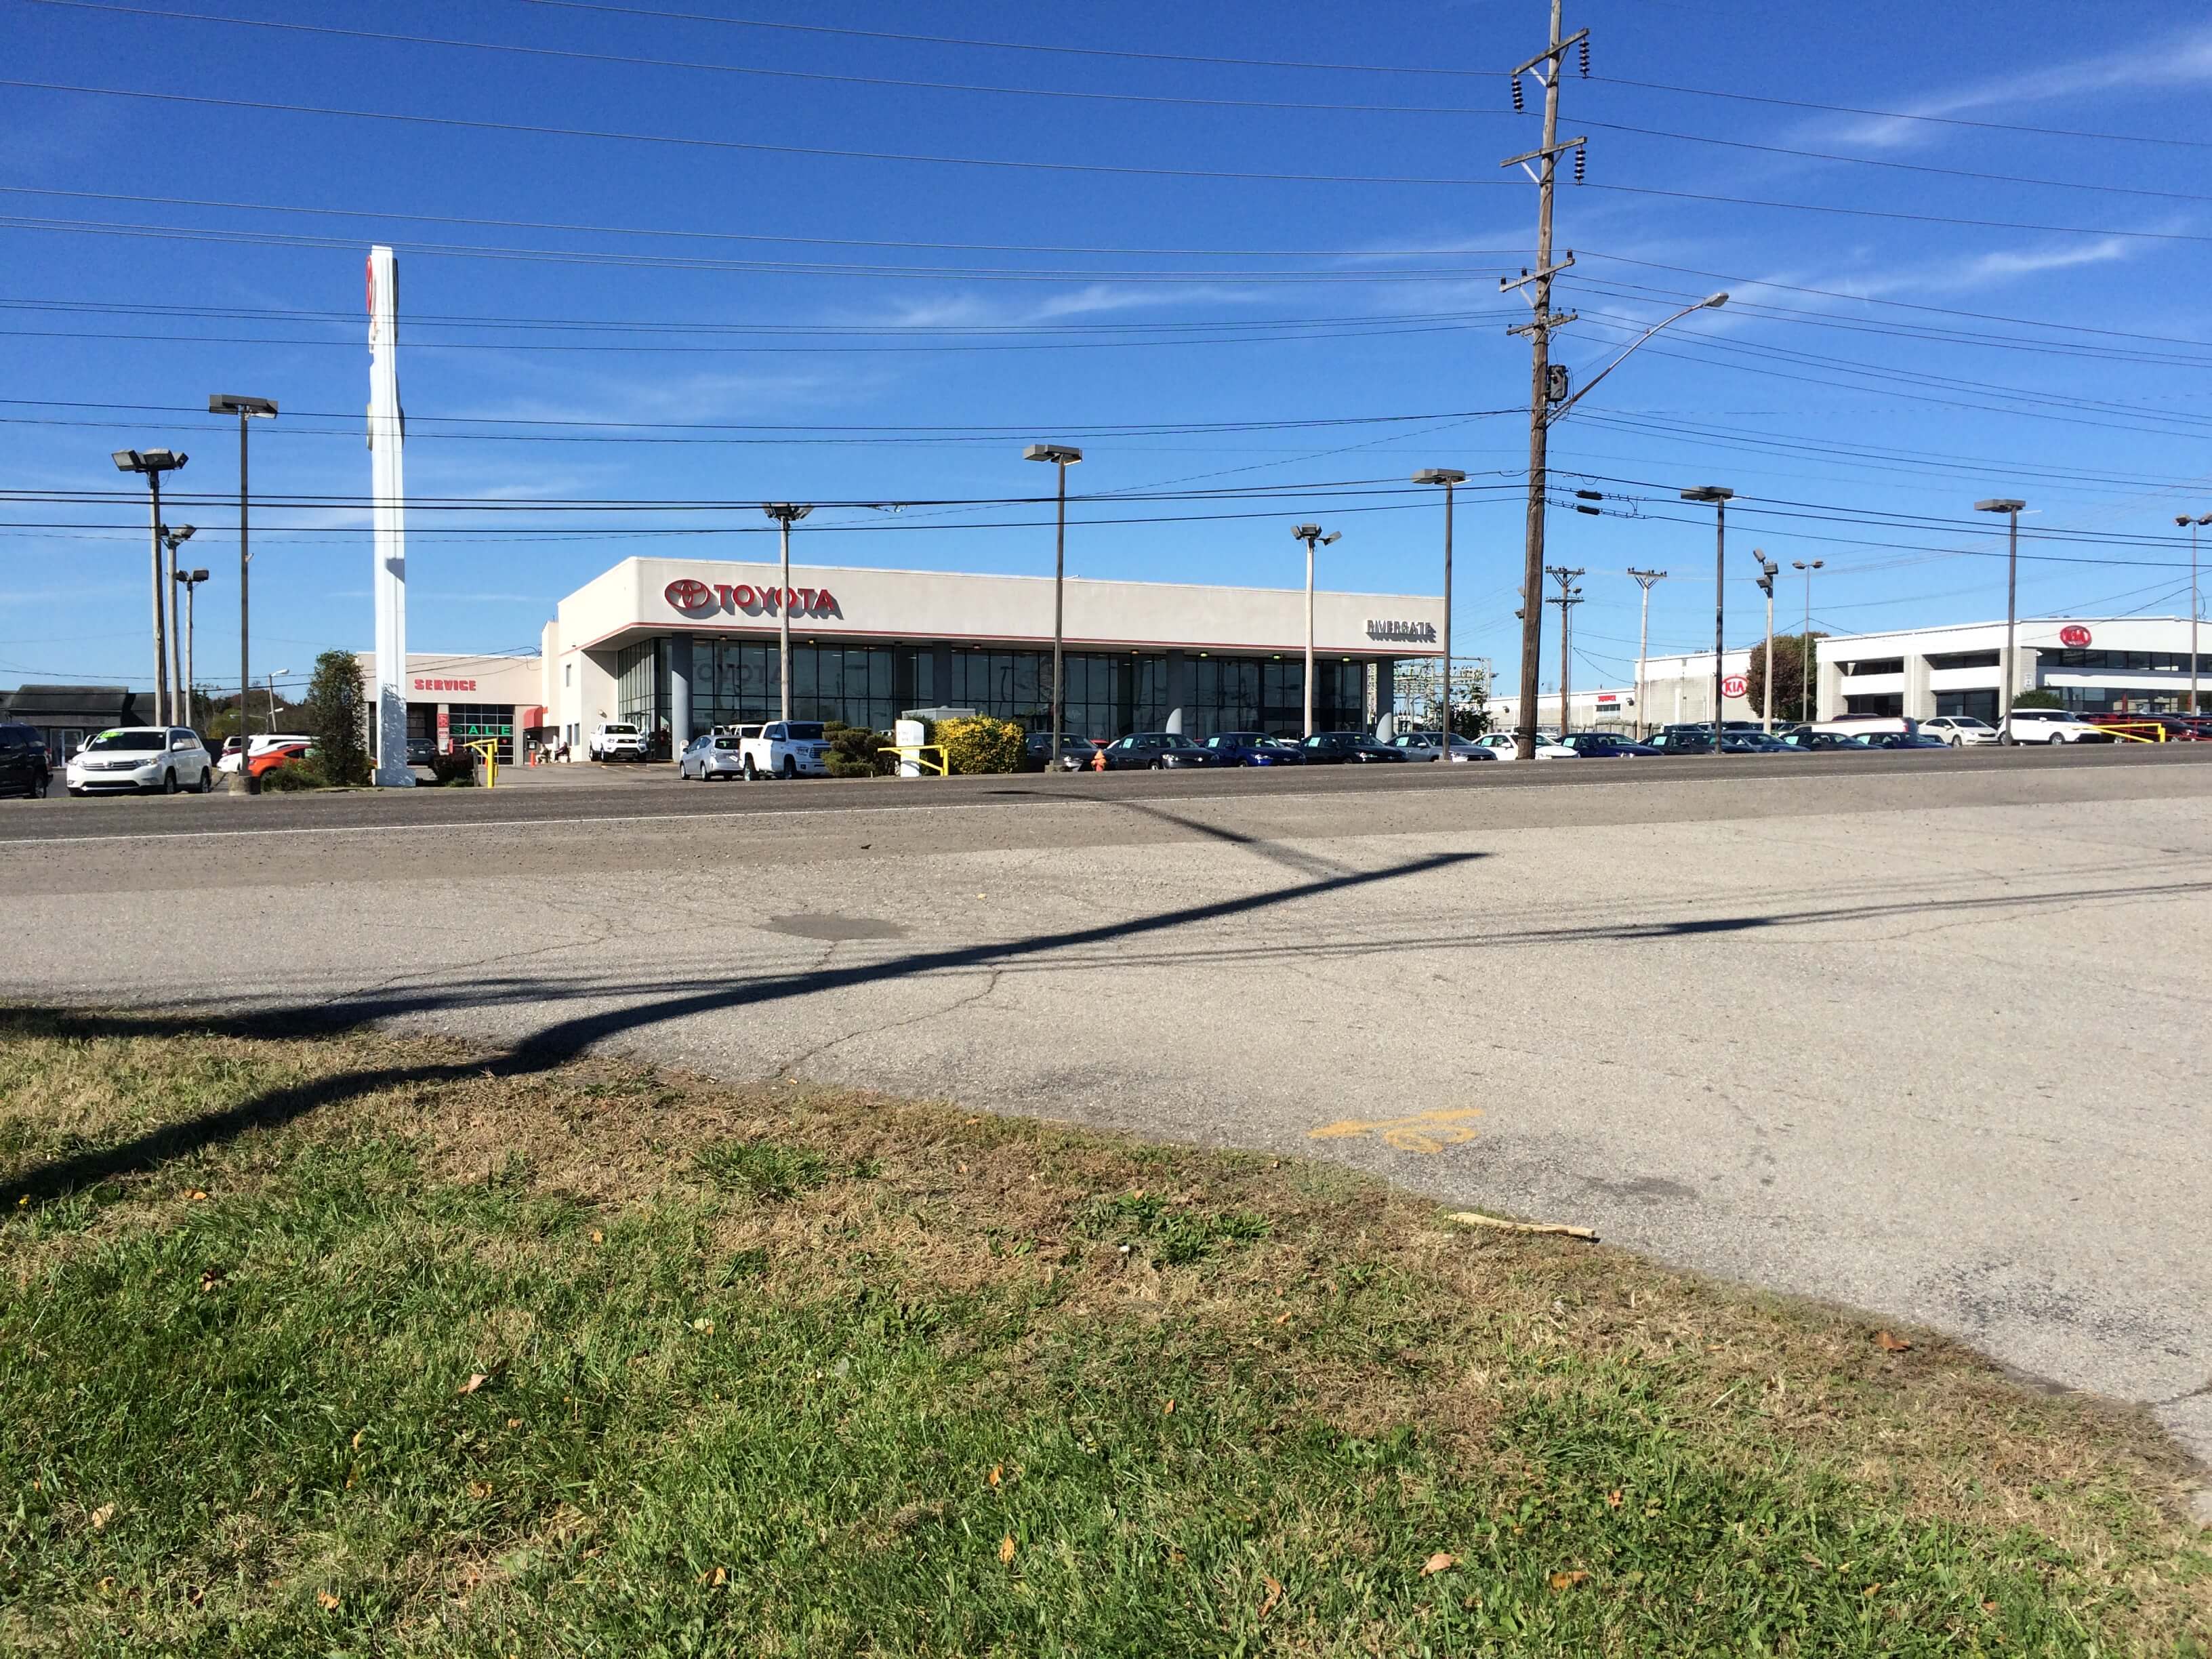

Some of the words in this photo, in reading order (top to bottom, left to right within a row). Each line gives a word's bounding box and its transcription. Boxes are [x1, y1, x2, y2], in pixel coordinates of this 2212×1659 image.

[713, 584, 835, 611] TOYOTA
[1367, 619, 1433, 635] RIVERGATE
[414, 679, 476, 691] SERVICE
[1725, 680, 1746, 693] KIA
[452, 726, 510, 736] SALE
